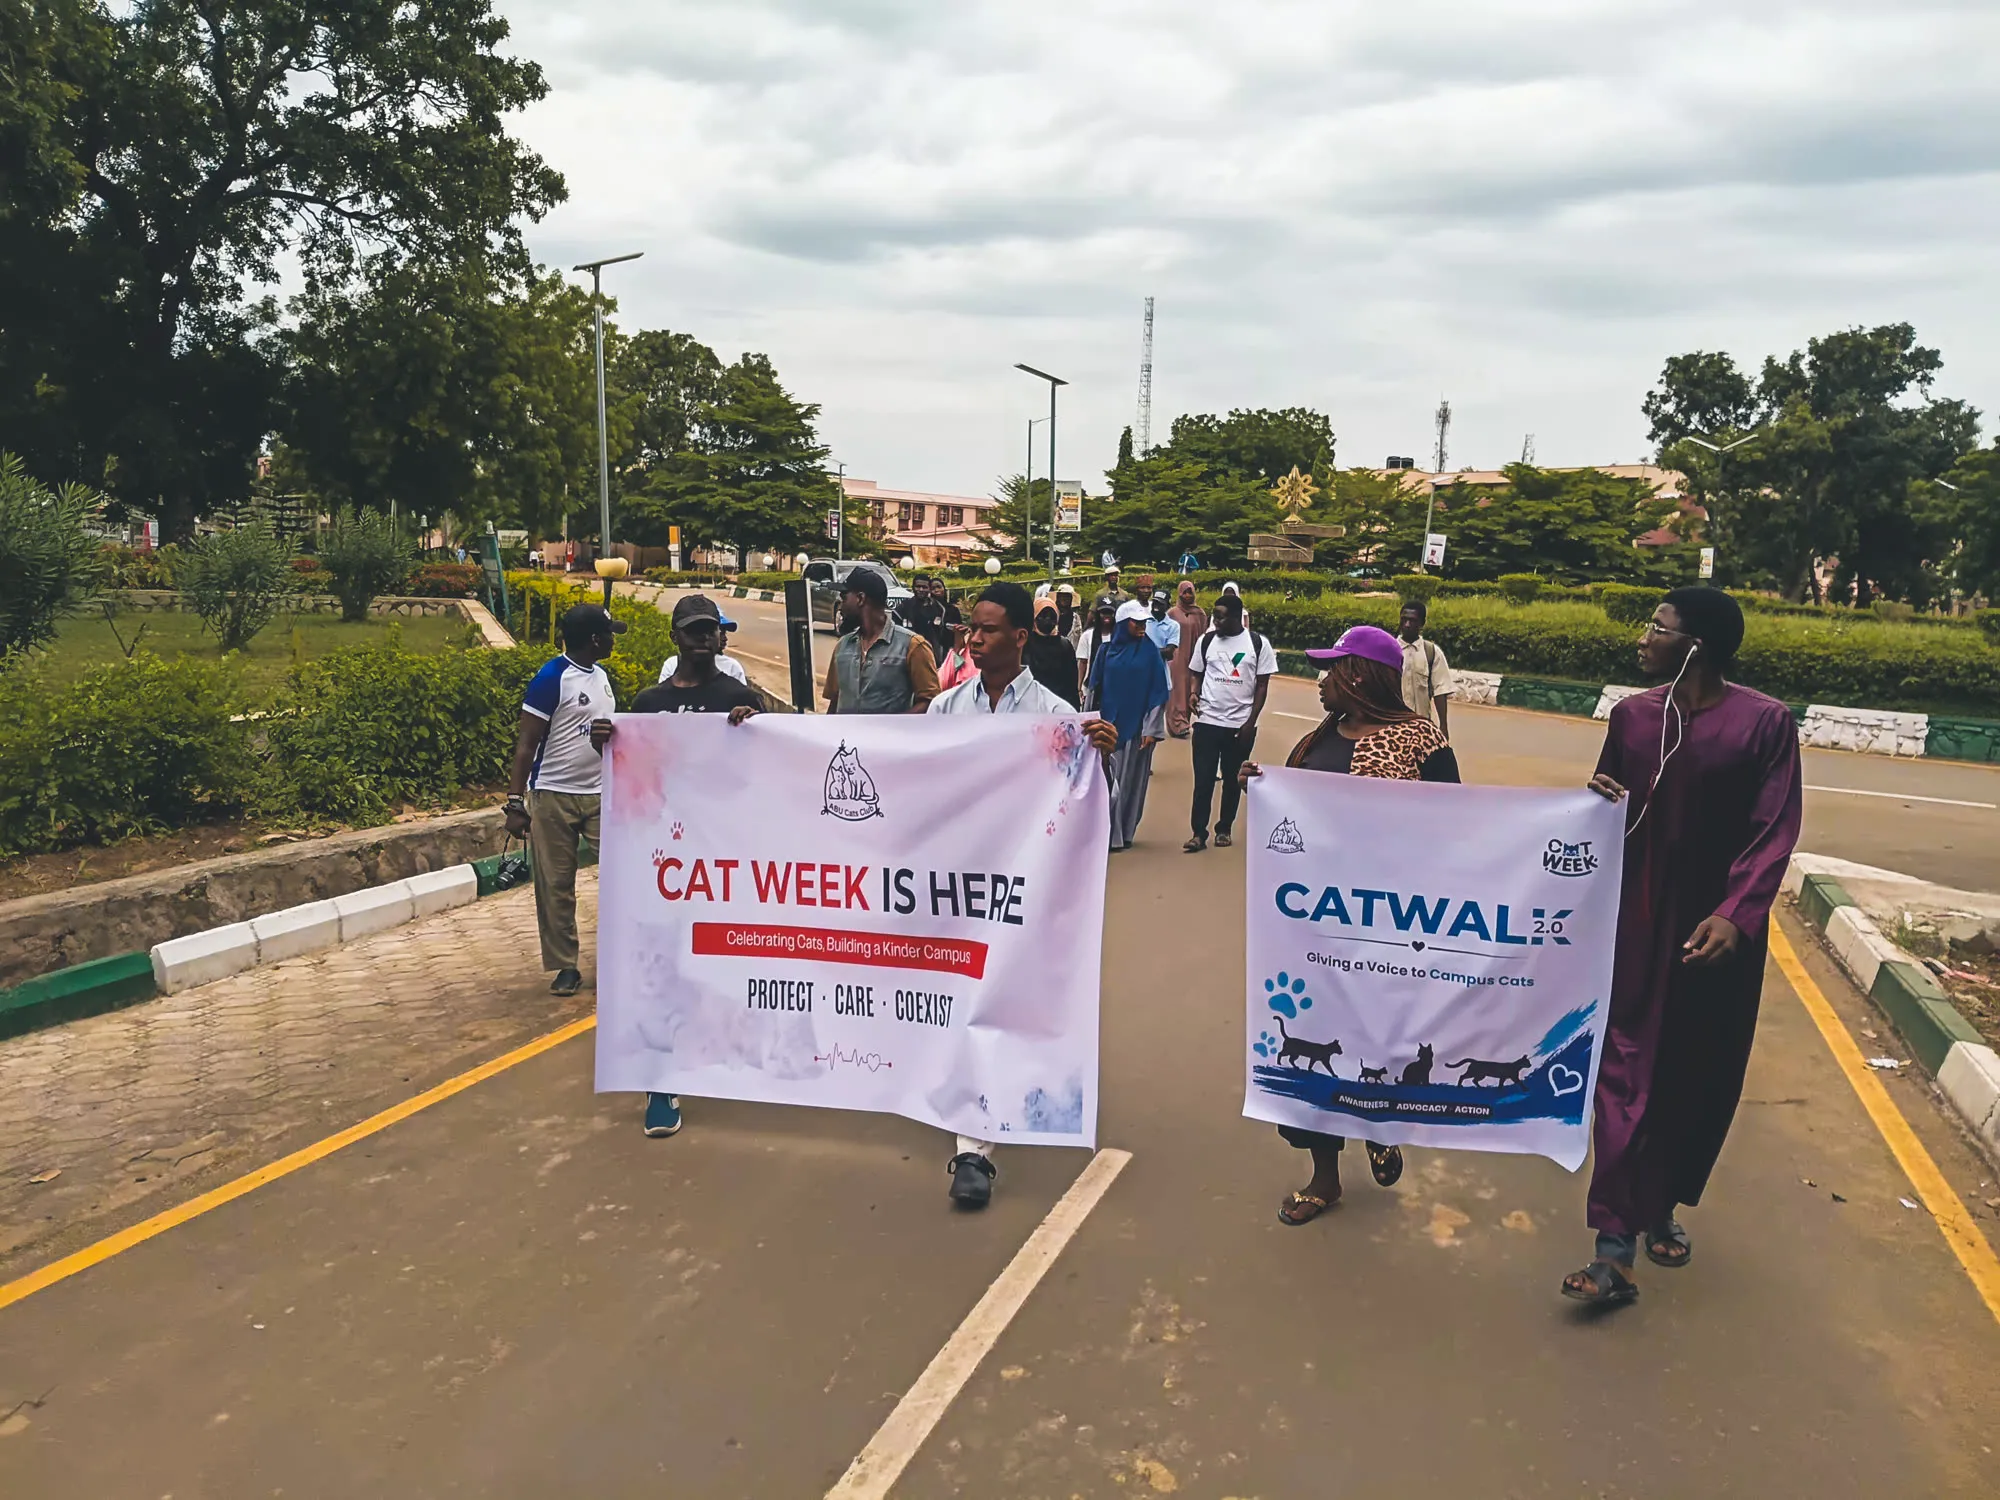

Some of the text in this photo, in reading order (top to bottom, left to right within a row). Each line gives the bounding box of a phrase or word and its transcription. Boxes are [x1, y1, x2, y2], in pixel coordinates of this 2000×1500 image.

[829, 803, 874, 817] ABU Cats Club
[1543, 851, 1598, 872] WEEK
[656, 857, 1026, 925] CAT WEEK IS HERE
[1533, 919, 1563, 935] 2.0
[726, 931, 971, 965] Celebrating Cats, Building a Kinder Campus
[1306, 952, 1535, 987] Giving a Voice to Campus Cats
[748, 978, 953, 1028] PROTECT CARE COEXIST
[1339, 1095, 1490, 1115] AWARENESS ADVOCACY ACTION
